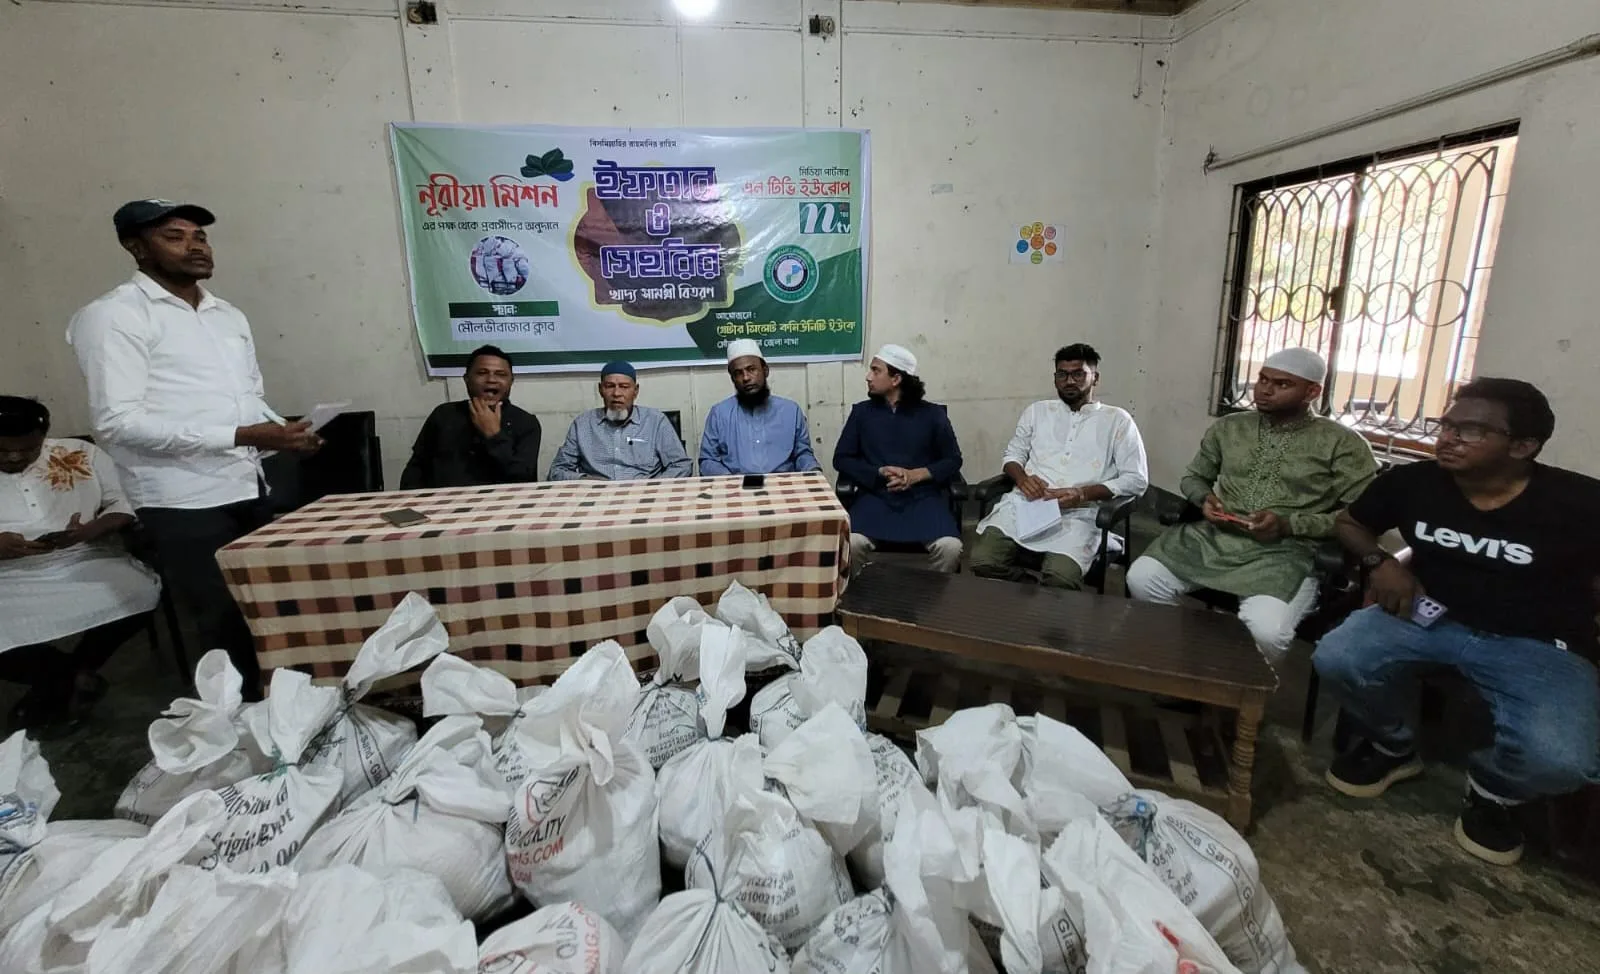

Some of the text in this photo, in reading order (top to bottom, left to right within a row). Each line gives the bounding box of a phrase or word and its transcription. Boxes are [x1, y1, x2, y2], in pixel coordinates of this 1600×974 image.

[490, 173, 560, 209] মিশন
[766, 175, 796, 196] টিভি
[799, 177, 851, 197] ইউরোপ
[422, 220, 436, 231] এর
[457, 220, 479, 231] থেকে
[525, 220, 560, 233] অনুদানে
[645, 202, 671, 237] ও
[609, 283, 715, 303] খাদ্য সামগ্রী বিতরণ
[458, 319, 556, 336] মৌলভীবাজার ক্লাব
